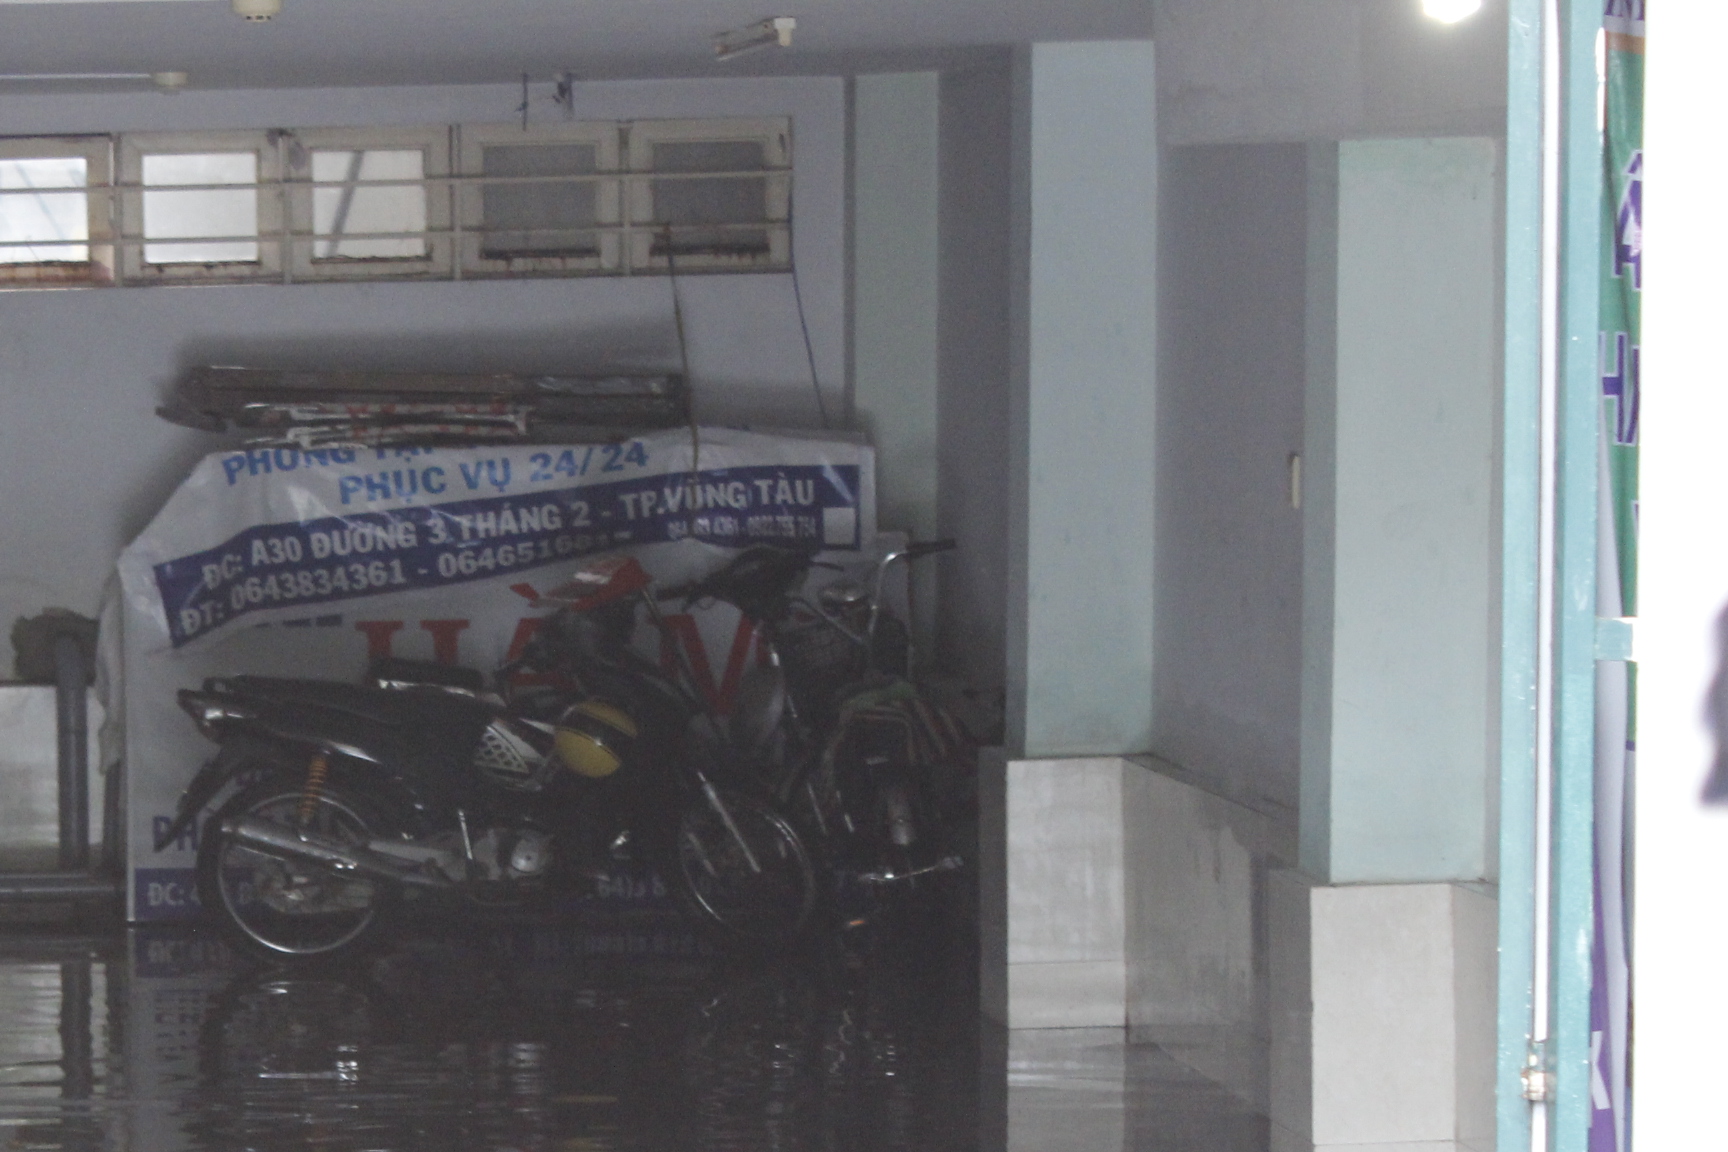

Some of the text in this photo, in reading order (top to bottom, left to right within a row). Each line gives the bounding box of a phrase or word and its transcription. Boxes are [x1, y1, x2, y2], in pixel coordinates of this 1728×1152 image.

[339, 441, 650, 504] PHỤC VỤ 24/24
[250, 535, 304, 567] A30
[428, 516, 449, 545] 3
[457, 501, 563, 542] THÁNG
[572, 500, 592, 528] 2
[754, 471, 815, 506] TÀU
[230, 558, 407, 611] 0643834361
